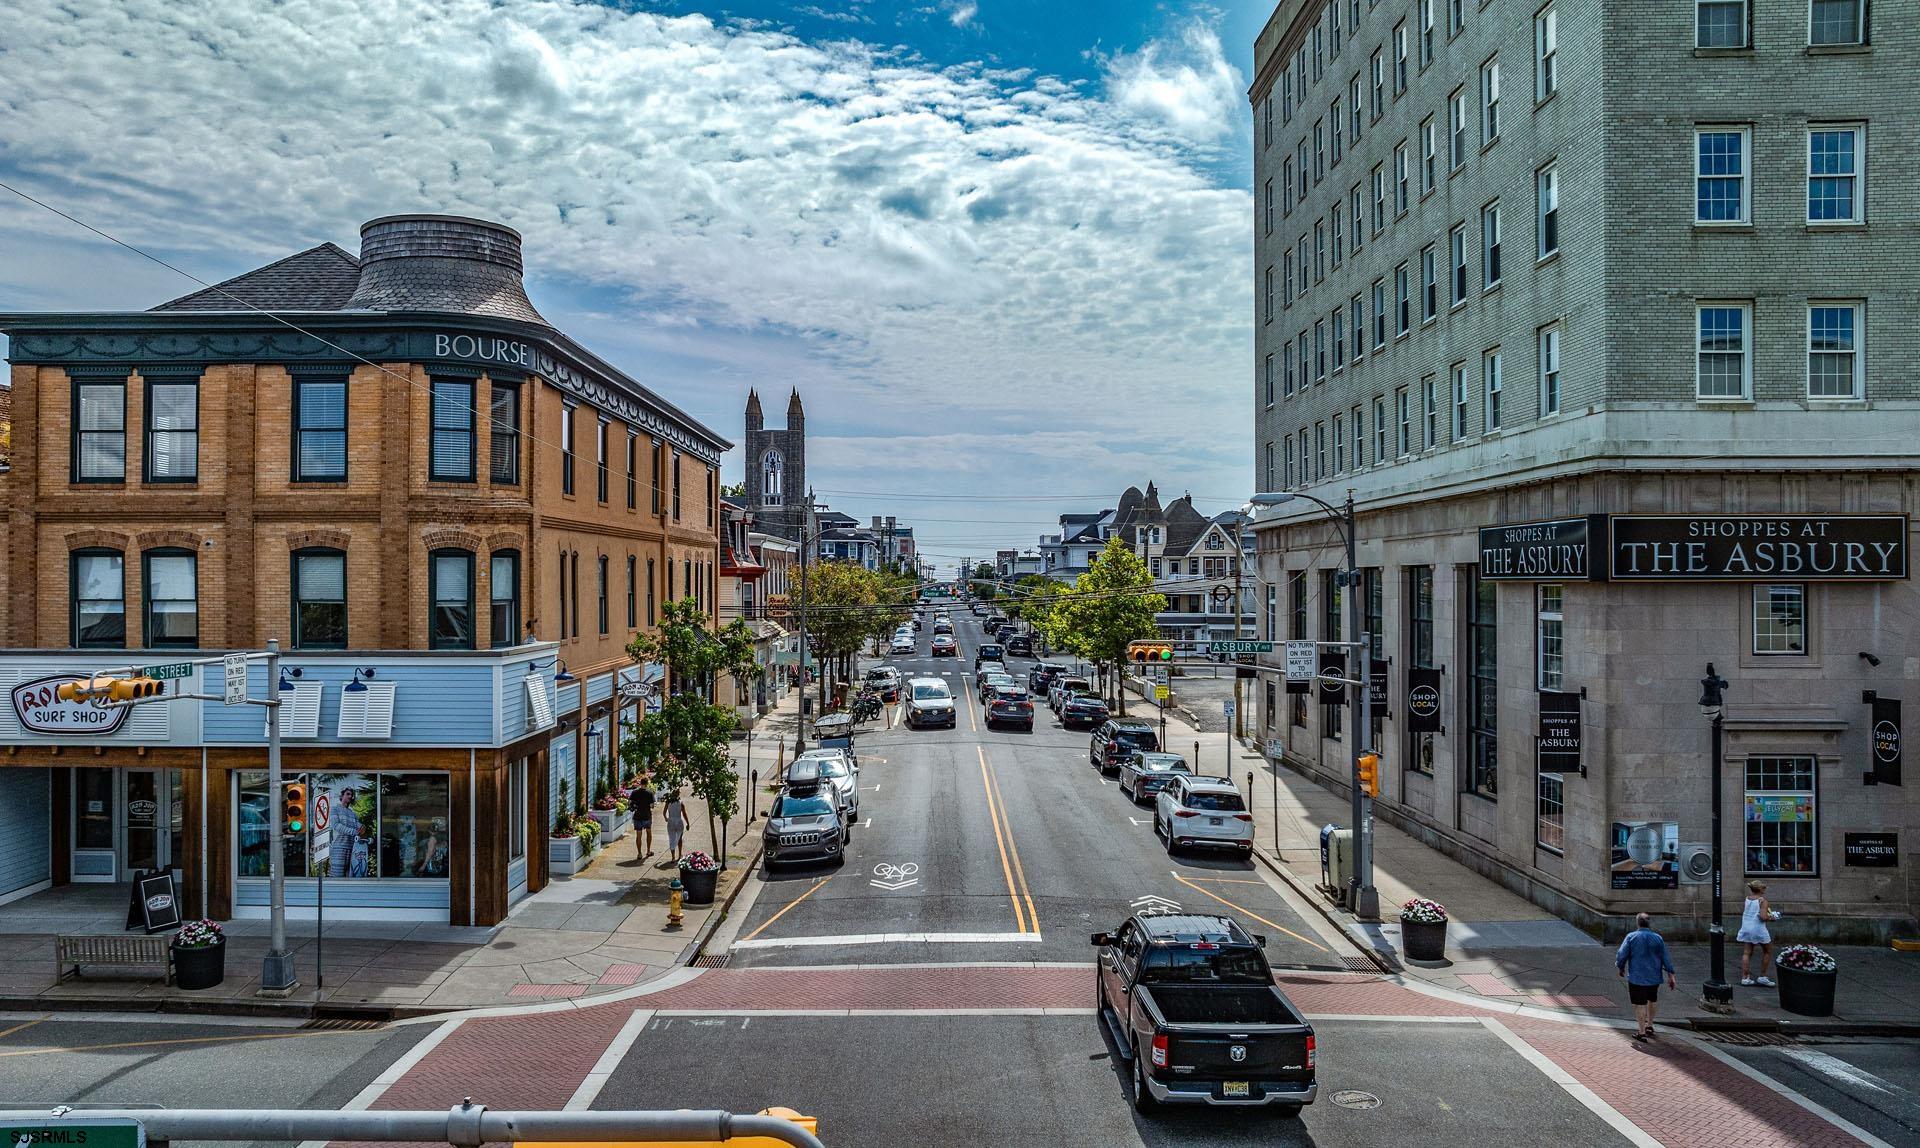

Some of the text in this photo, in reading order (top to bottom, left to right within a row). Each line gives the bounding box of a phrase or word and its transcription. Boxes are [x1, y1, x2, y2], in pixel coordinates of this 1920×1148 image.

[435, 334, 528, 365] BOURSE
[1505, 526, 1557, 543] SHOPPES AT
[1688, 521, 1831, 537] SHOPPES AT
[1483, 544, 1585, 574] THE ASBURY
[1620, 541, 1899, 573] THE ASBURY
[1213, 642, 1261, 651] ASBURY
[160, 664, 192, 678] STREET
[34, 710, 108, 723] SURF SHOP
[1540, 739, 1579, 747] ASBURY
[1876, 731, 1897, 741] SHOP
[1876, 741, 1897, 751] LOCAL
